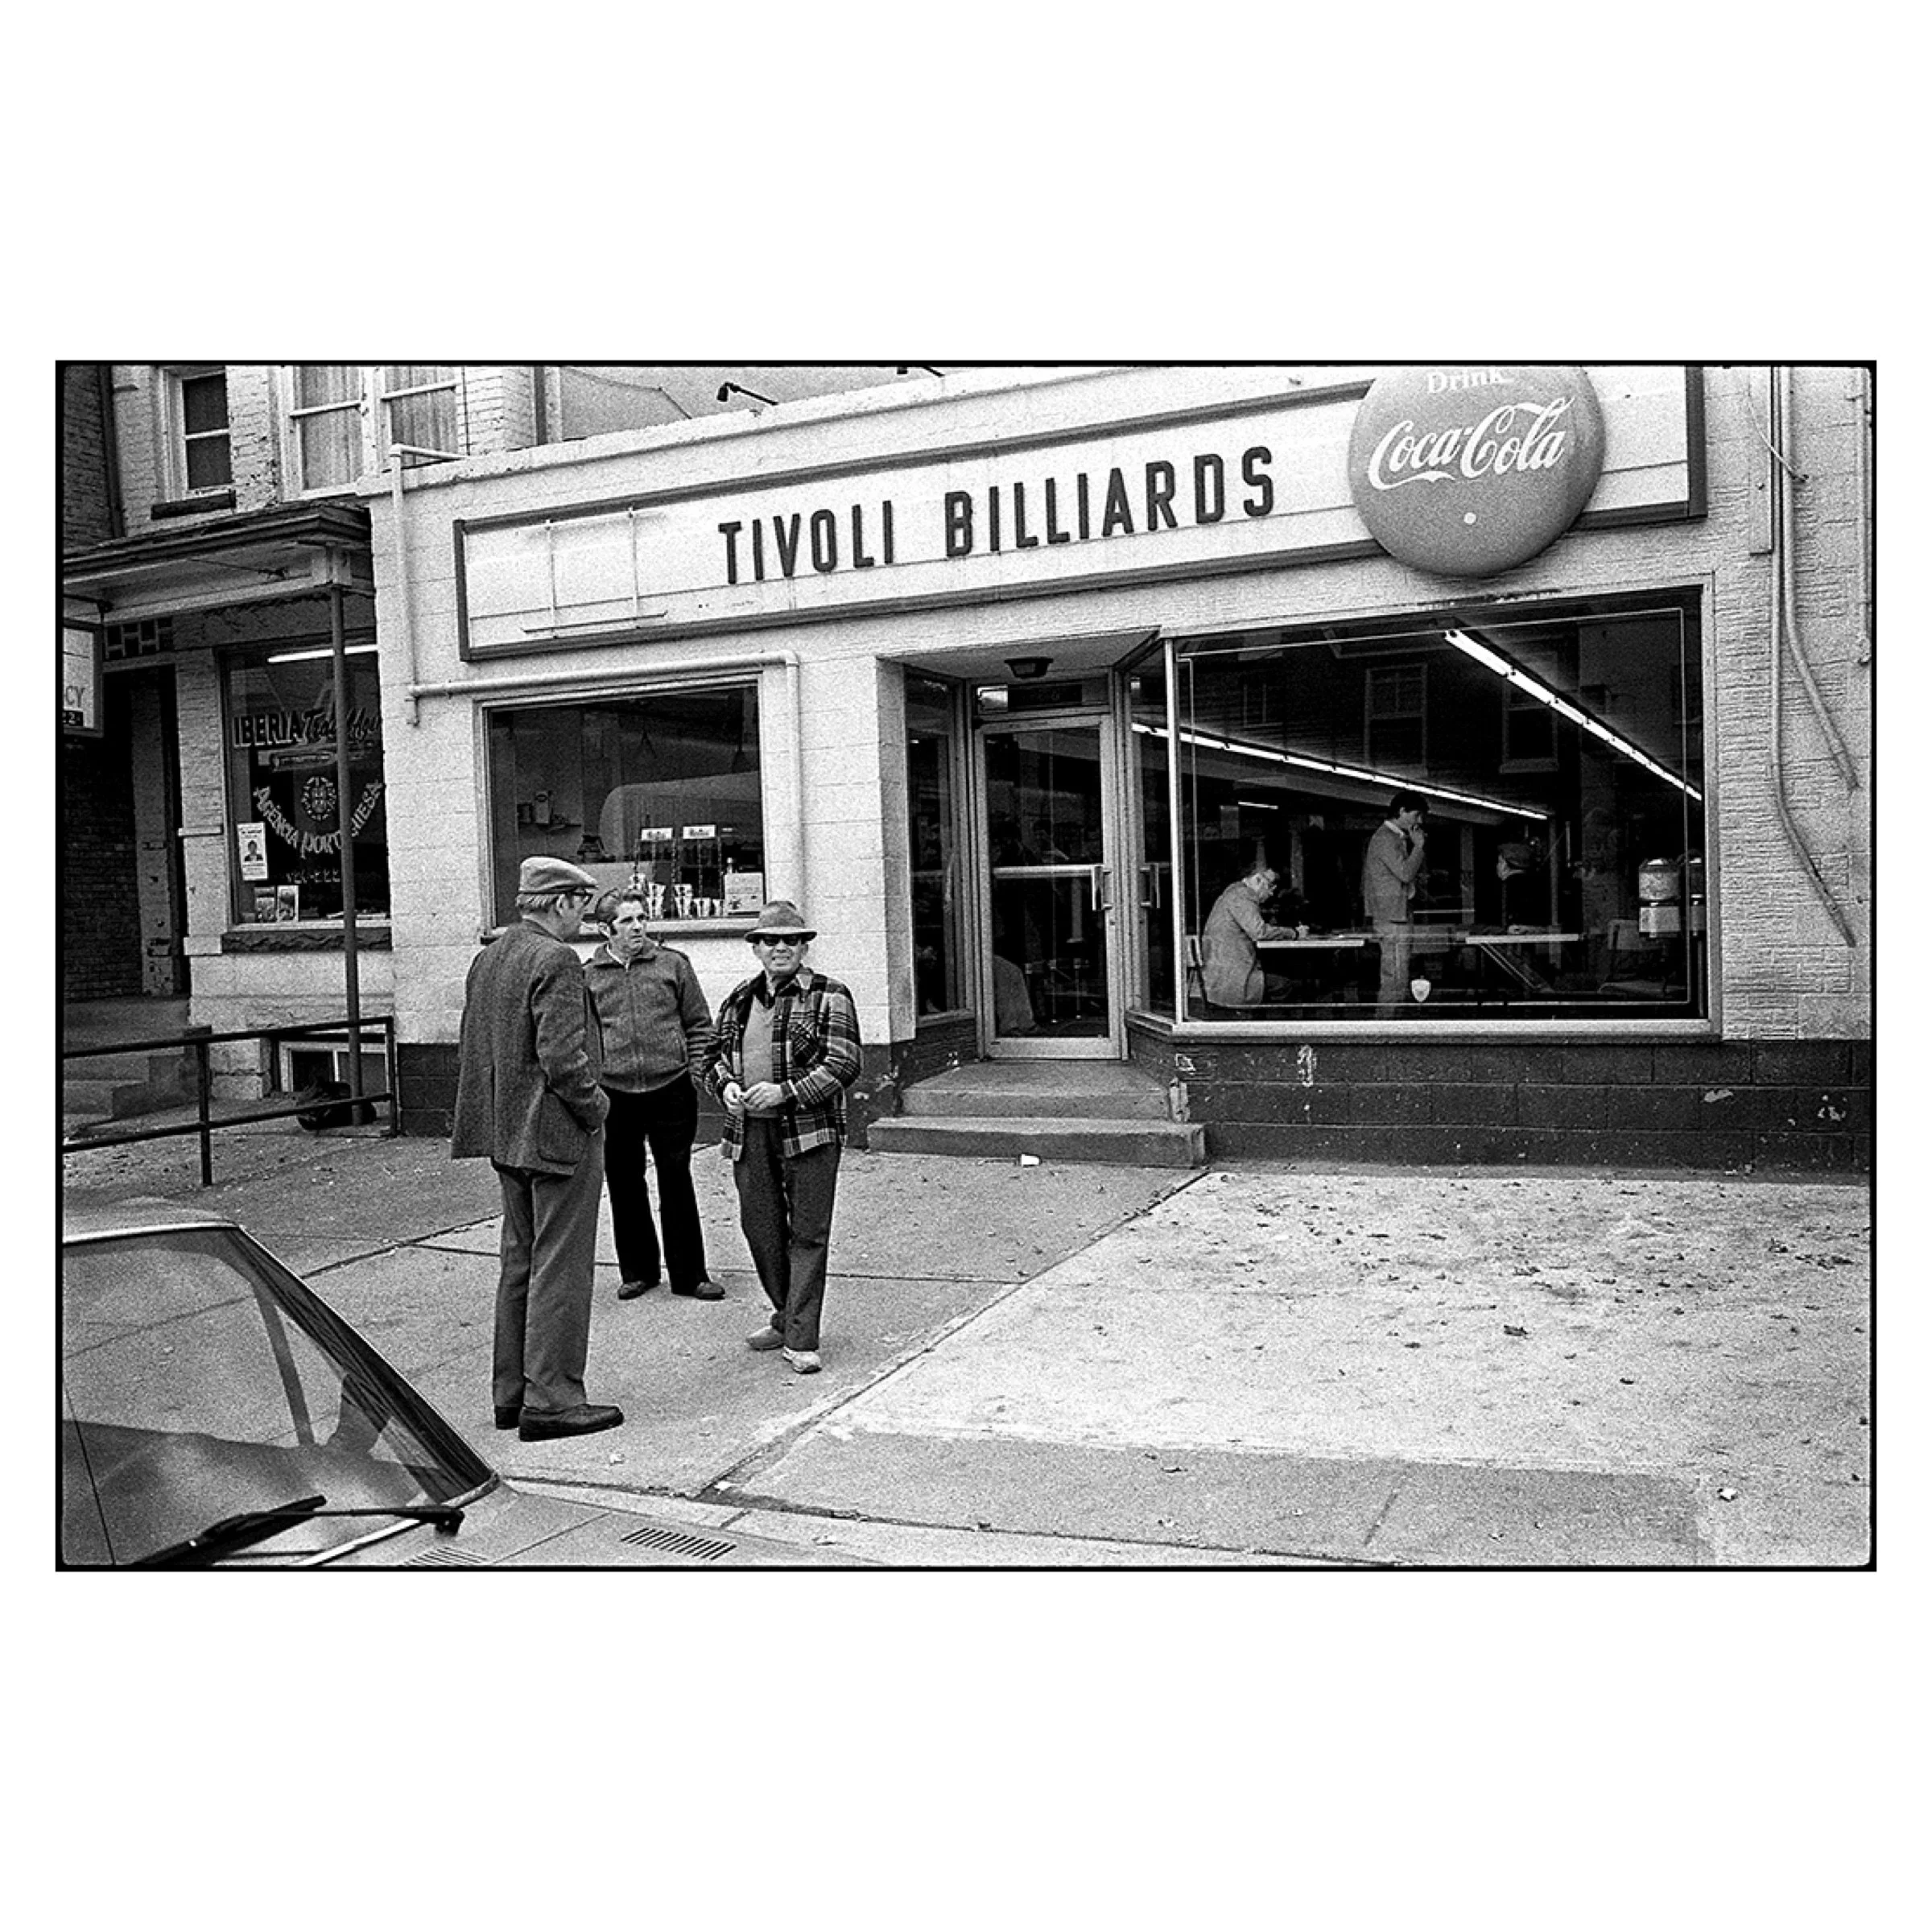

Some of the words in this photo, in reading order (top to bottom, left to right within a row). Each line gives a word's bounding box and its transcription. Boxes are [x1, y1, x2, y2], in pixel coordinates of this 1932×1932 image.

[1426, 368, 1513, 394] Drink
[1368, 396, 1575, 491] Coca-Cola
[719, 499, 894, 584] TIVOLI
[945, 446, 1274, 558] BILLIARDS
[233, 710, 308, 747] IBERIA
